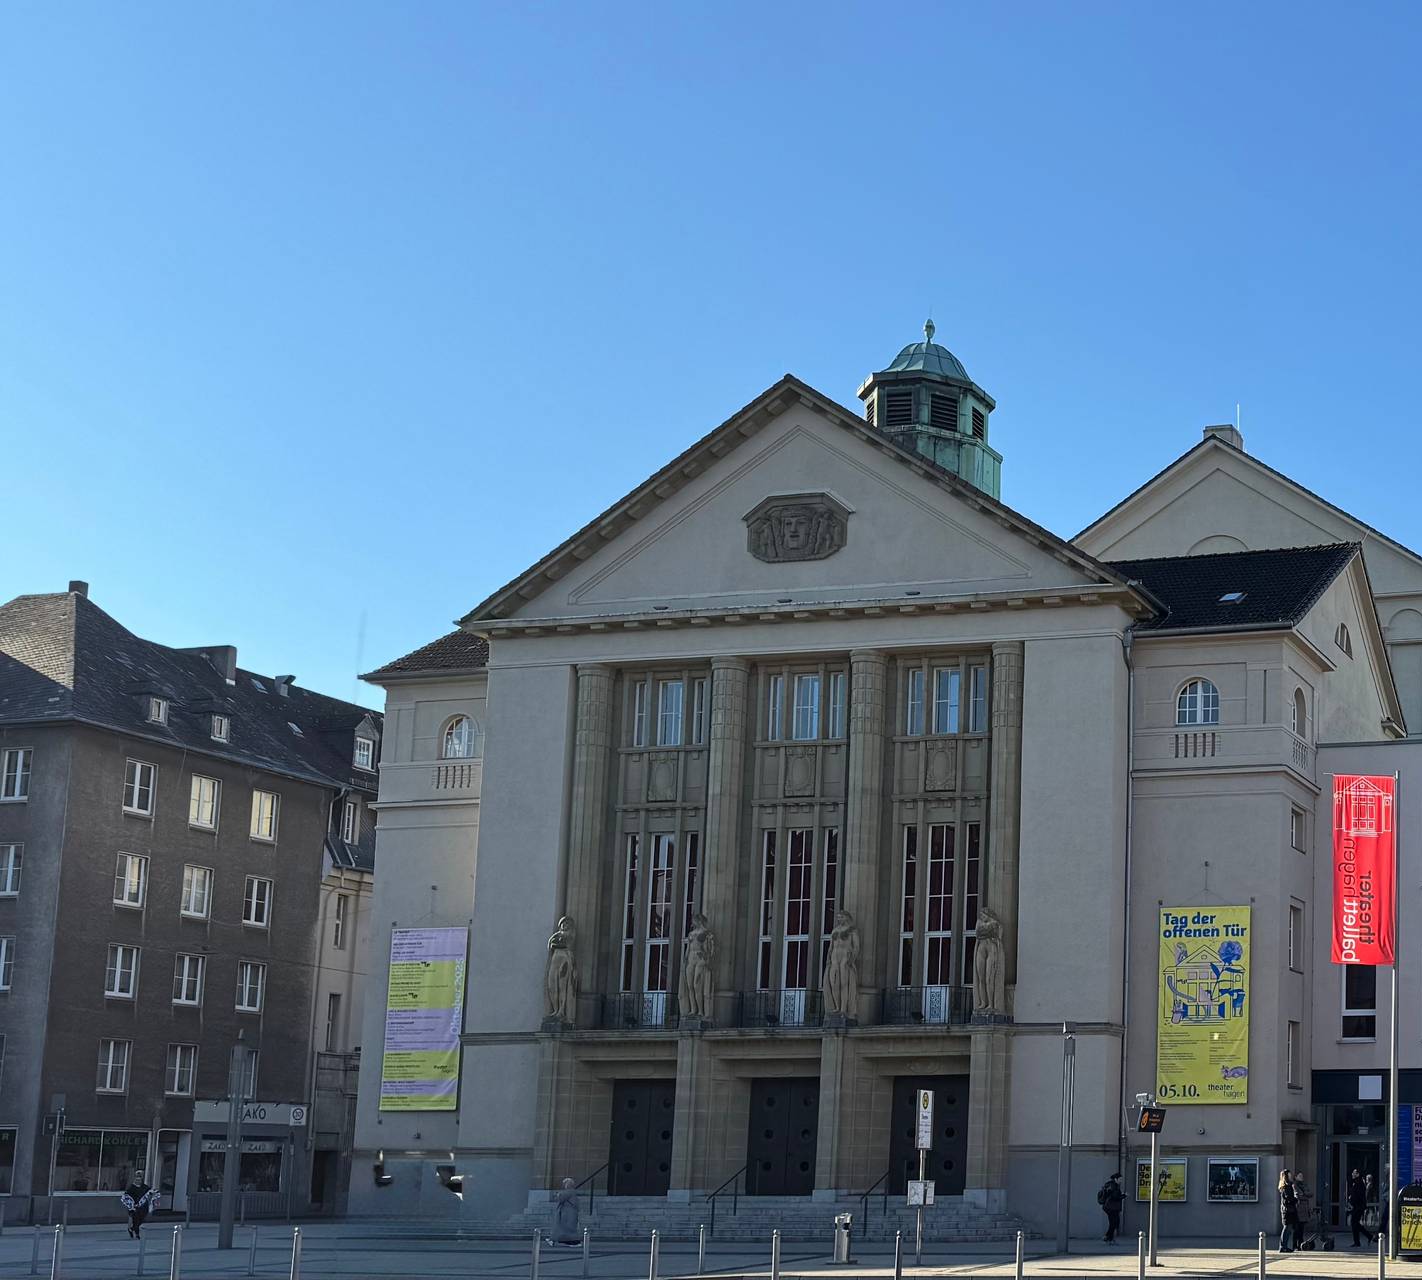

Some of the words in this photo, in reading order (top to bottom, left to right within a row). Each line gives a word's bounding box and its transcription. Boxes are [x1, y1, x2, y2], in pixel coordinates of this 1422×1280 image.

[1163, 913, 1188, 928] Tag
[1192, 912, 1217, 925] der
[1163, 926, 1220, 938] offenen
[1223, 924, 1247, 937] Tür
[1159, 1084, 1200, 1098] 05.10.
[1208, 1084, 1233, 1092] theater
[242, 1104, 267, 1121] AKO
